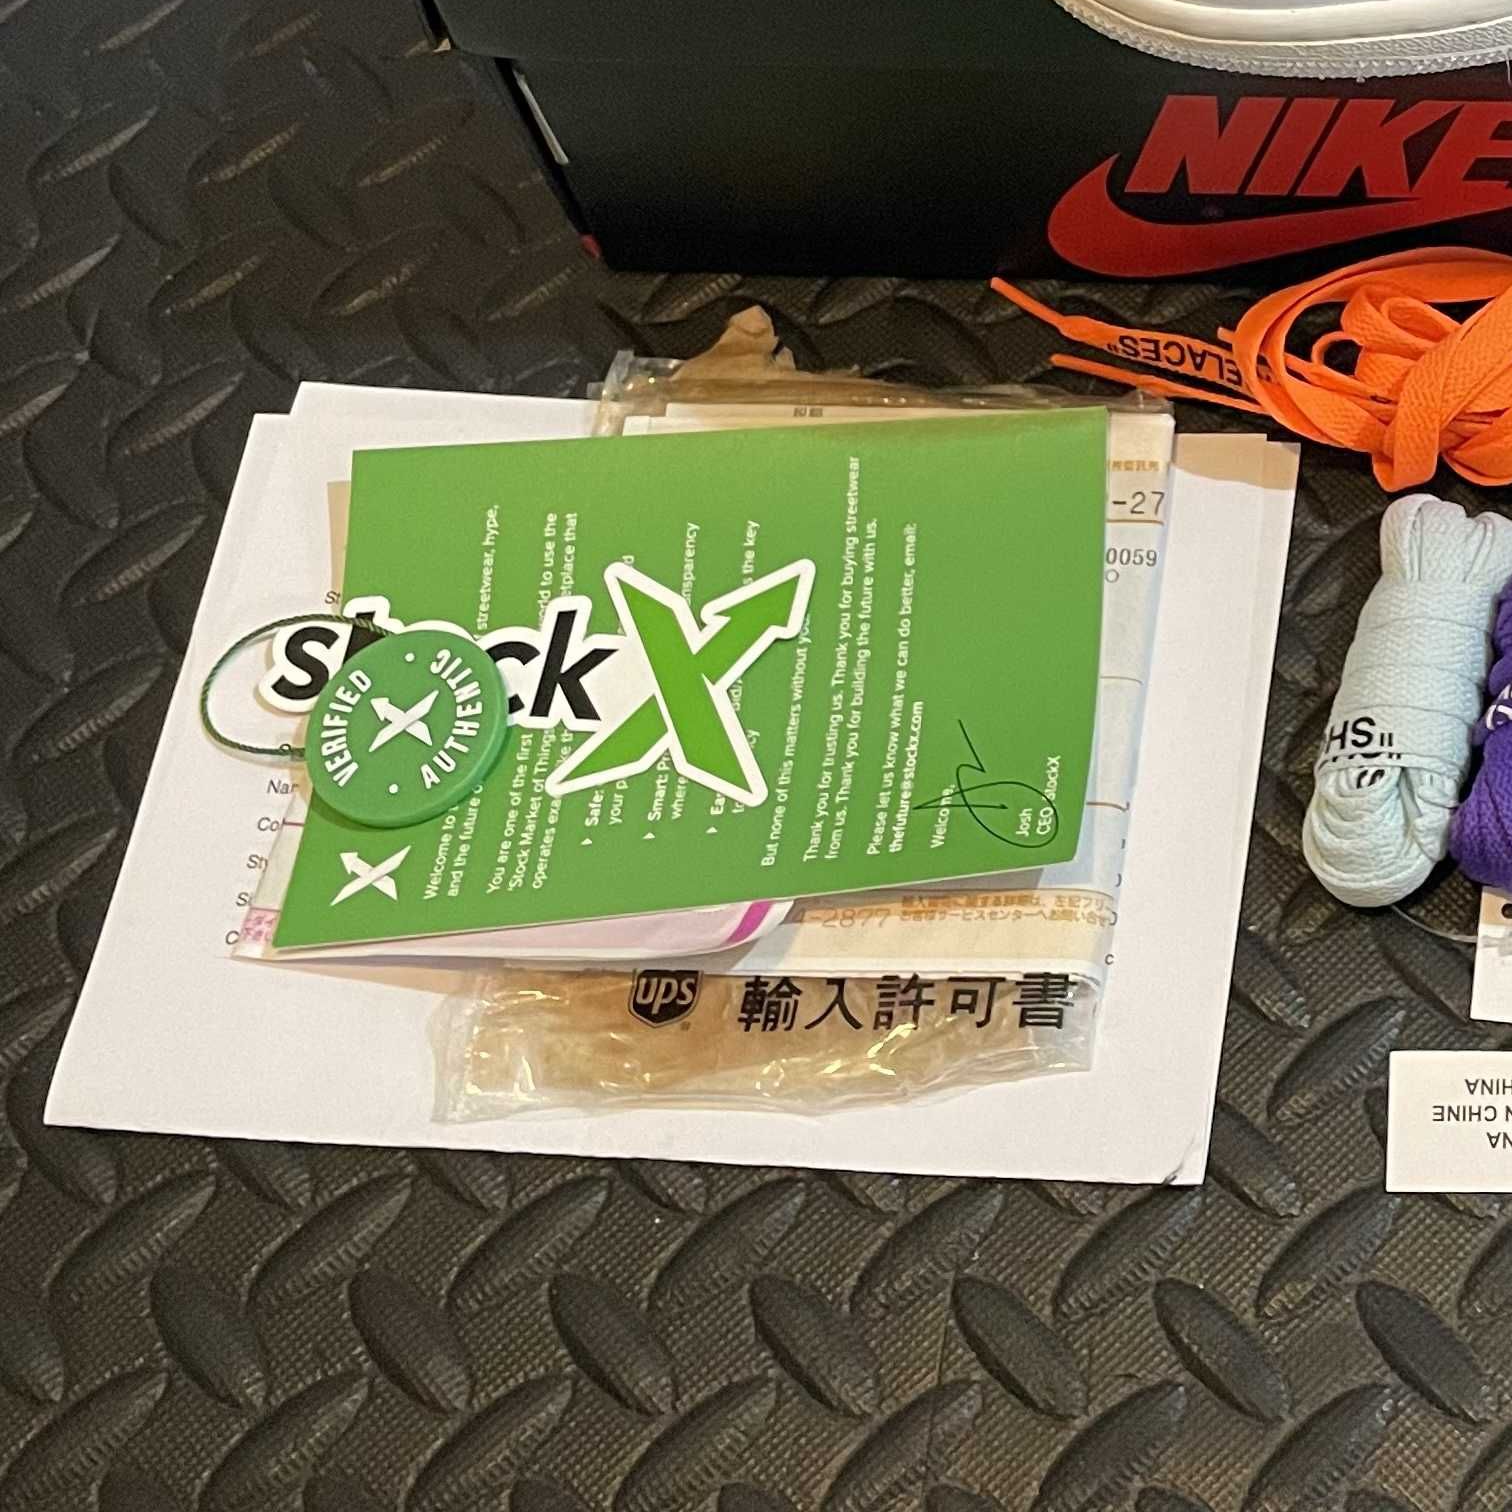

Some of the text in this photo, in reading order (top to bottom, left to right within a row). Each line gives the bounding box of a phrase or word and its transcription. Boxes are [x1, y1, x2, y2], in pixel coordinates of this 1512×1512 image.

[544, 513, 557, 537] the
[744, 521, 760, 546] key
[543, 542, 555, 567] use
[742, 550, 755, 574] the
[540, 571, 553, 586] to
[897, 618, 911, 637] do
[803, 456, 860, 862] Thank you for trusting us. Thank you for buying streetwear
[896, 641, 909, 666] can
[518, 796, 542, 845] Market
[534, 778, 547, 792] of
[561, 513, 577, 541] that
[793, 648, 808, 700] without
[894, 670, 907, 690] we
[423, 833, 452, 900] Welcome
[443, 815, 456, 829] to
[483, 504, 499, 546] hype,
[825, 518, 878, 859] from us. Thank you for building the future with us.
[420, 648, 483, 789] AUTHENTIC
[889, 694, 906, 728] what
[321, 669, 372, 788] VERIFIED
[784, 703, 801, 756] matters
[517, 733, 533, 760] first
[882, 731, 899, 768] know
[512, 764, 528, 787] the
[777, 760, 793, 785] this
[880, 771, 894, 788] us
[889, 700, 924, 853] thefuture@stockx.com
[509, 791, 523, 805] of
[584, 790, 604, 826] Safe:
[608, 794, 623, 824] your
[648, 775, 668, 821] Smart:
[771, 789, 787, 802] of
[875, 791, 891, 808] let
[460, 798, 480, 840] future
[504, 810, 518, 836] one
[767, 806, 786, 840] none
[1015, 808, 1033, 837] Josh
[867, 811, 888, 855] Please
[454, 844, 470, 866] the
[496, 840, 512, 863] are
[532, 827, 556, 888] operates
[761, 842, 779, 866] But
[448, 871, 464, 897] and
[486, 867, 505, 893] You
[636, 976, 696, 1015] ups
[737, 970, 1078, 1035] 輸入許可書
[1432, 1105, 1497, 1122] CHINE
